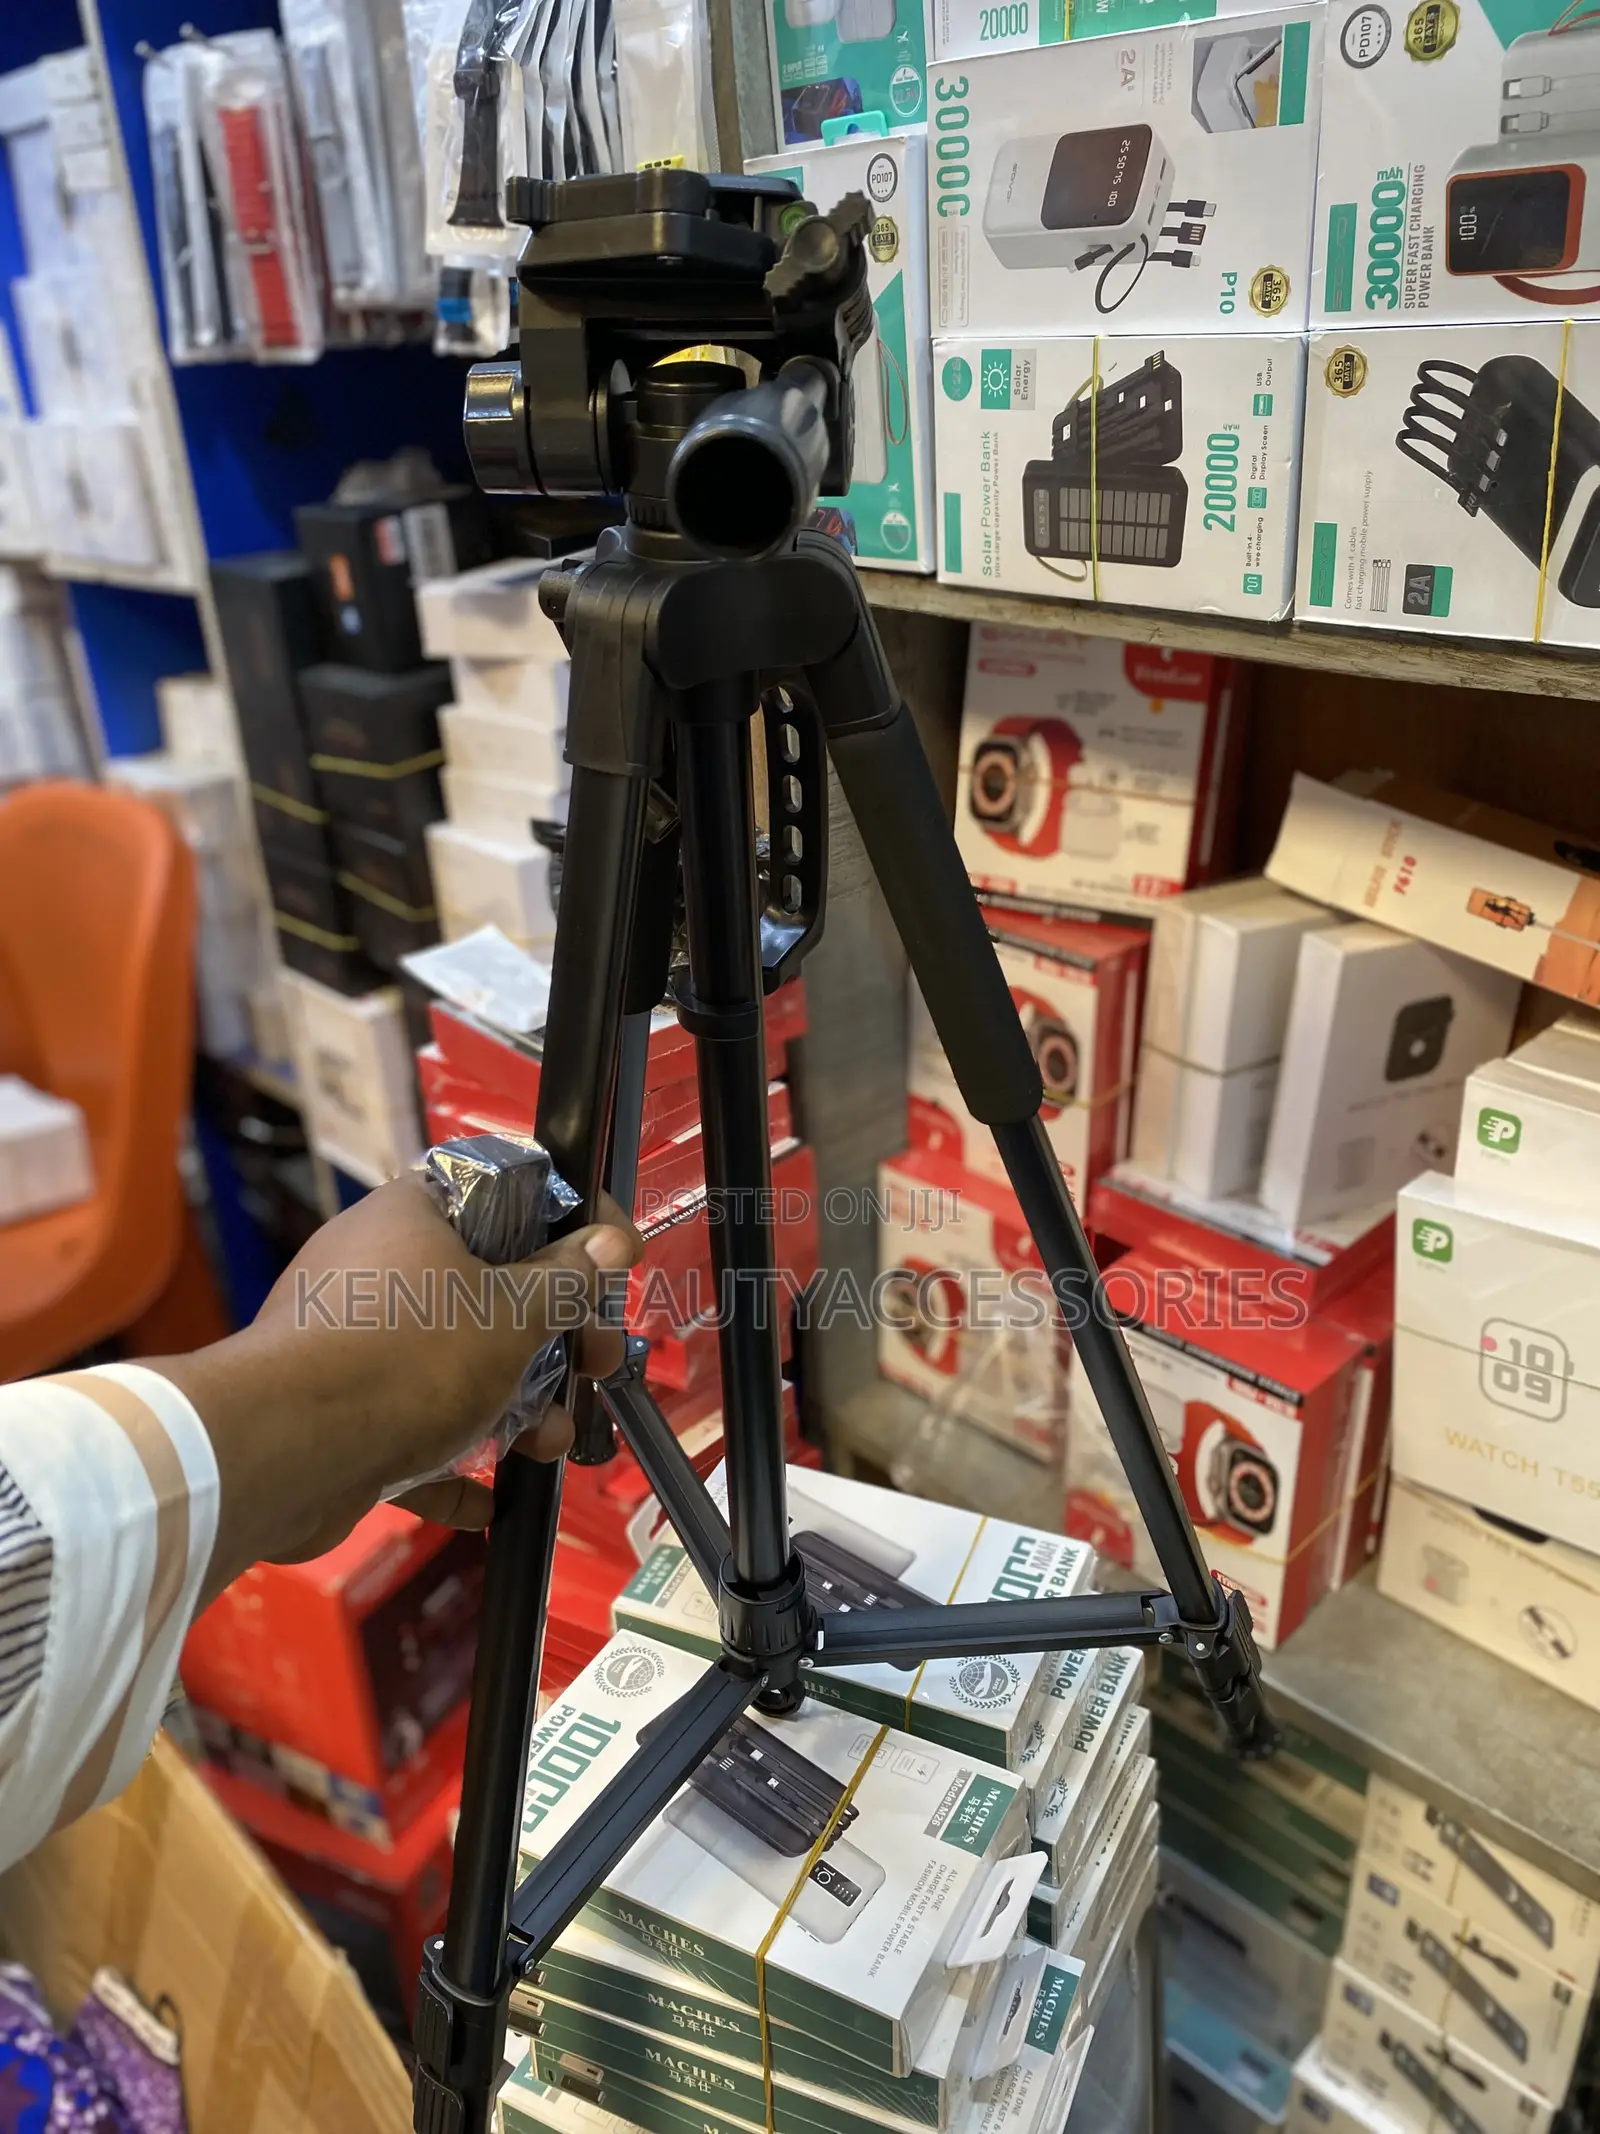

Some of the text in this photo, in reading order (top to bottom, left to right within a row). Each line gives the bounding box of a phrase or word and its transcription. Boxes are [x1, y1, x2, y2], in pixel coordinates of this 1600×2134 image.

[978, 2, 1029, 41] 20000
[1358, 16, 1372, 59] PD107
[1413, 18, 1425, 45] 365
[872, 172, 893, 183] PD107
[877, 222, 889, 232] 365
[1365, 167, 1406, 310] 30000 mAh
[1404, 164, 1426, 309] SUPER FAST CHARGING
[1418, 225, 1435, 309] POWER BANK
[1219, 272, 1237, 314] P10
[1271, 279, 1281, 302] 365
[1021, 359, 1031, 401] Energy
[1265, 358, 1273, 387] Output
[1334, 361, 1343, 383] 365
[1259, 450, 1267, 480] Display
[1203, 433, 1240, 533] 20000
[1363, 470, 1374, 498] supply
[980, 430, 992, 577] Solar Power Bank
[1361, 501, 1370, 527] power
[1256, 517, 1264, 551] charging
[1349, 526, 1357, 551] cables
[1359, 528, 1367, 559] mobile
[1357, 558, 1367, 595] charging
[1407, 575, 1431, 606] 2A
[1344, 586, 1355, 609] Comes
[1509, 1338, 1554, 1374] 10
[1492, 1362, 1552, 1404] 09
[1444, 1426, 1540, 1478] WATCH
[1030, 1540, 1060, 1573] MAH
[1051, 1546, 1081, 1589] BANK
[1073, 1651, 1132, 1754] POWER BANK
[530, 1703, 577, 1762] POWE
[931, 1776, 966, 1827] Model:M26
[958, 1796, 982, 1824] 马车仕
[964, 1787, 1001, 1844] MACHES
[930, 1864, 948, 1895] CHARGE
[948, 1868, 959, 1887] ALL
[867, 1859, 937, 1979] FASHION MOBILE POWER BANK
[916, 1893, 932, 1914] FAST
[931, 1893, 946, 1912] ONE
[617, 1908, 706, 1957] MACHES
[640, 1932, 683, 1960] 马车仕
[893, 1923, 916, 1955] STABLE
[647, 1992, 741, 2034] MACHES
[671, 2013, 717, 2038] 马车仕
[1034, 1976, 1065, 2042] MACHES
[644, 2047, 736, 2091] MACHES
[668, 2068, 712, 2095] 马车仕
[1005, 2064, 1023, 2100] CHARGE
[1023, 2069, 1034, 2086] ALL
[996, 2099, 1010, 2124] FAST
[1011, 2097, 1024, 2117] ONE
